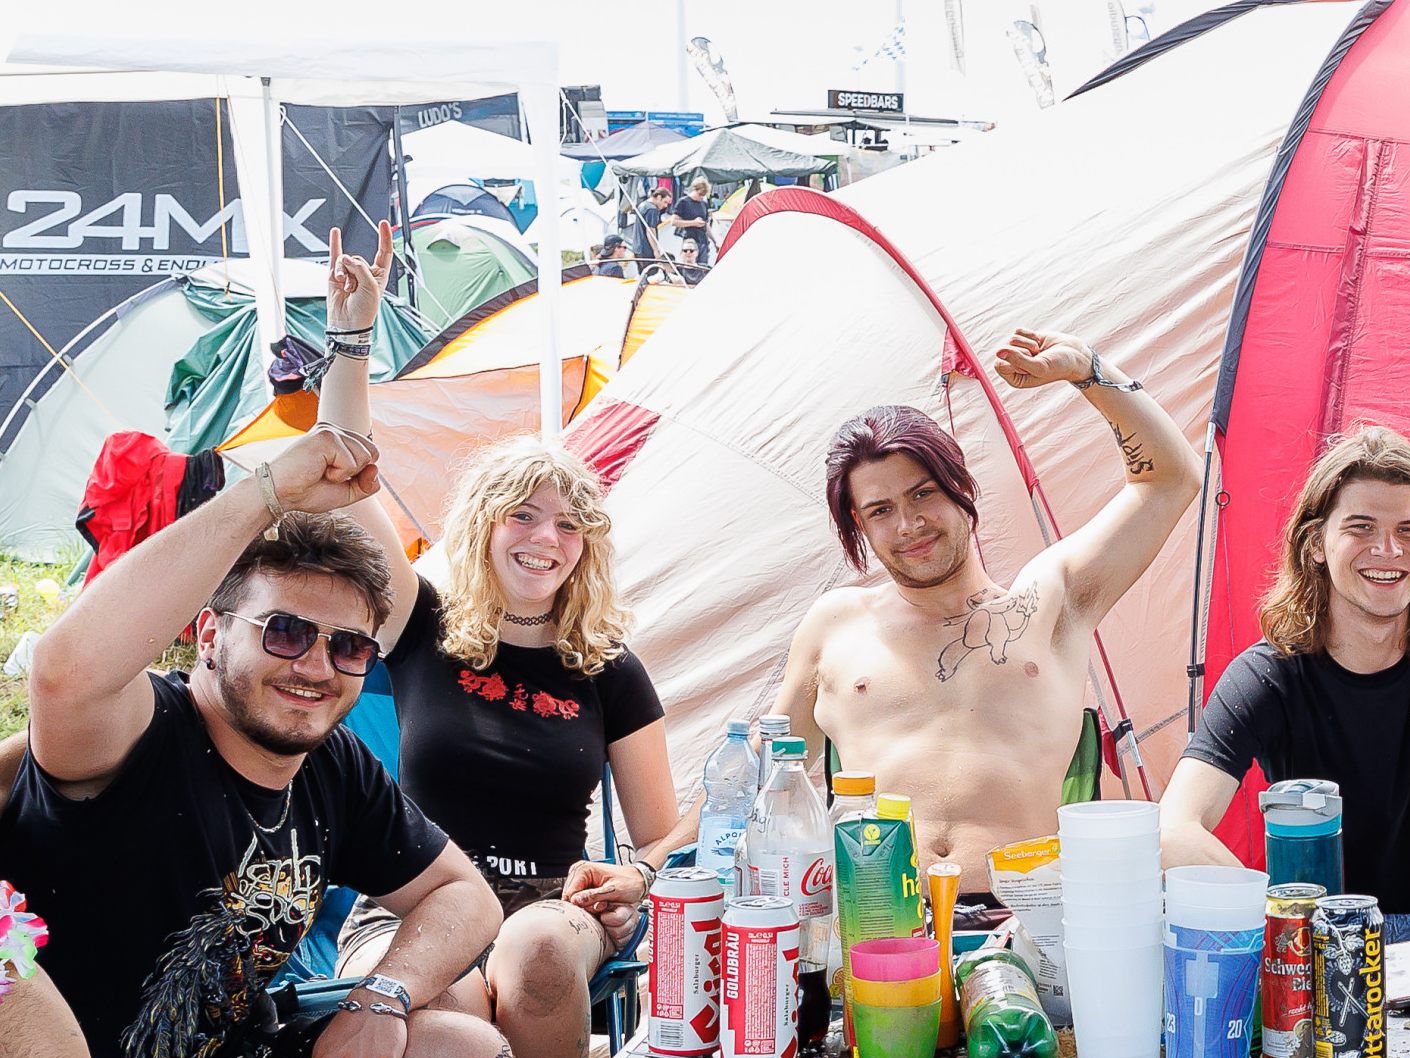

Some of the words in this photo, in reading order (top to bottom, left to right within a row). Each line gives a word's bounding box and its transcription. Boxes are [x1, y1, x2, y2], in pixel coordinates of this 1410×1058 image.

[837, 92, 898, 109] SPEEDBARS
[418, 101, 463, 128] LUDO'S
[0, 257, 135, 271] MOTOCROSS
[141, 257, 153, 273] &
[1003, 847, 1051, 861] Seeberger
[726, 932, 740, 999] GOLDBRÄU
[1166, 1015, 1176, 1034] 23
[1227, 1019, 1243, 1039] 20
